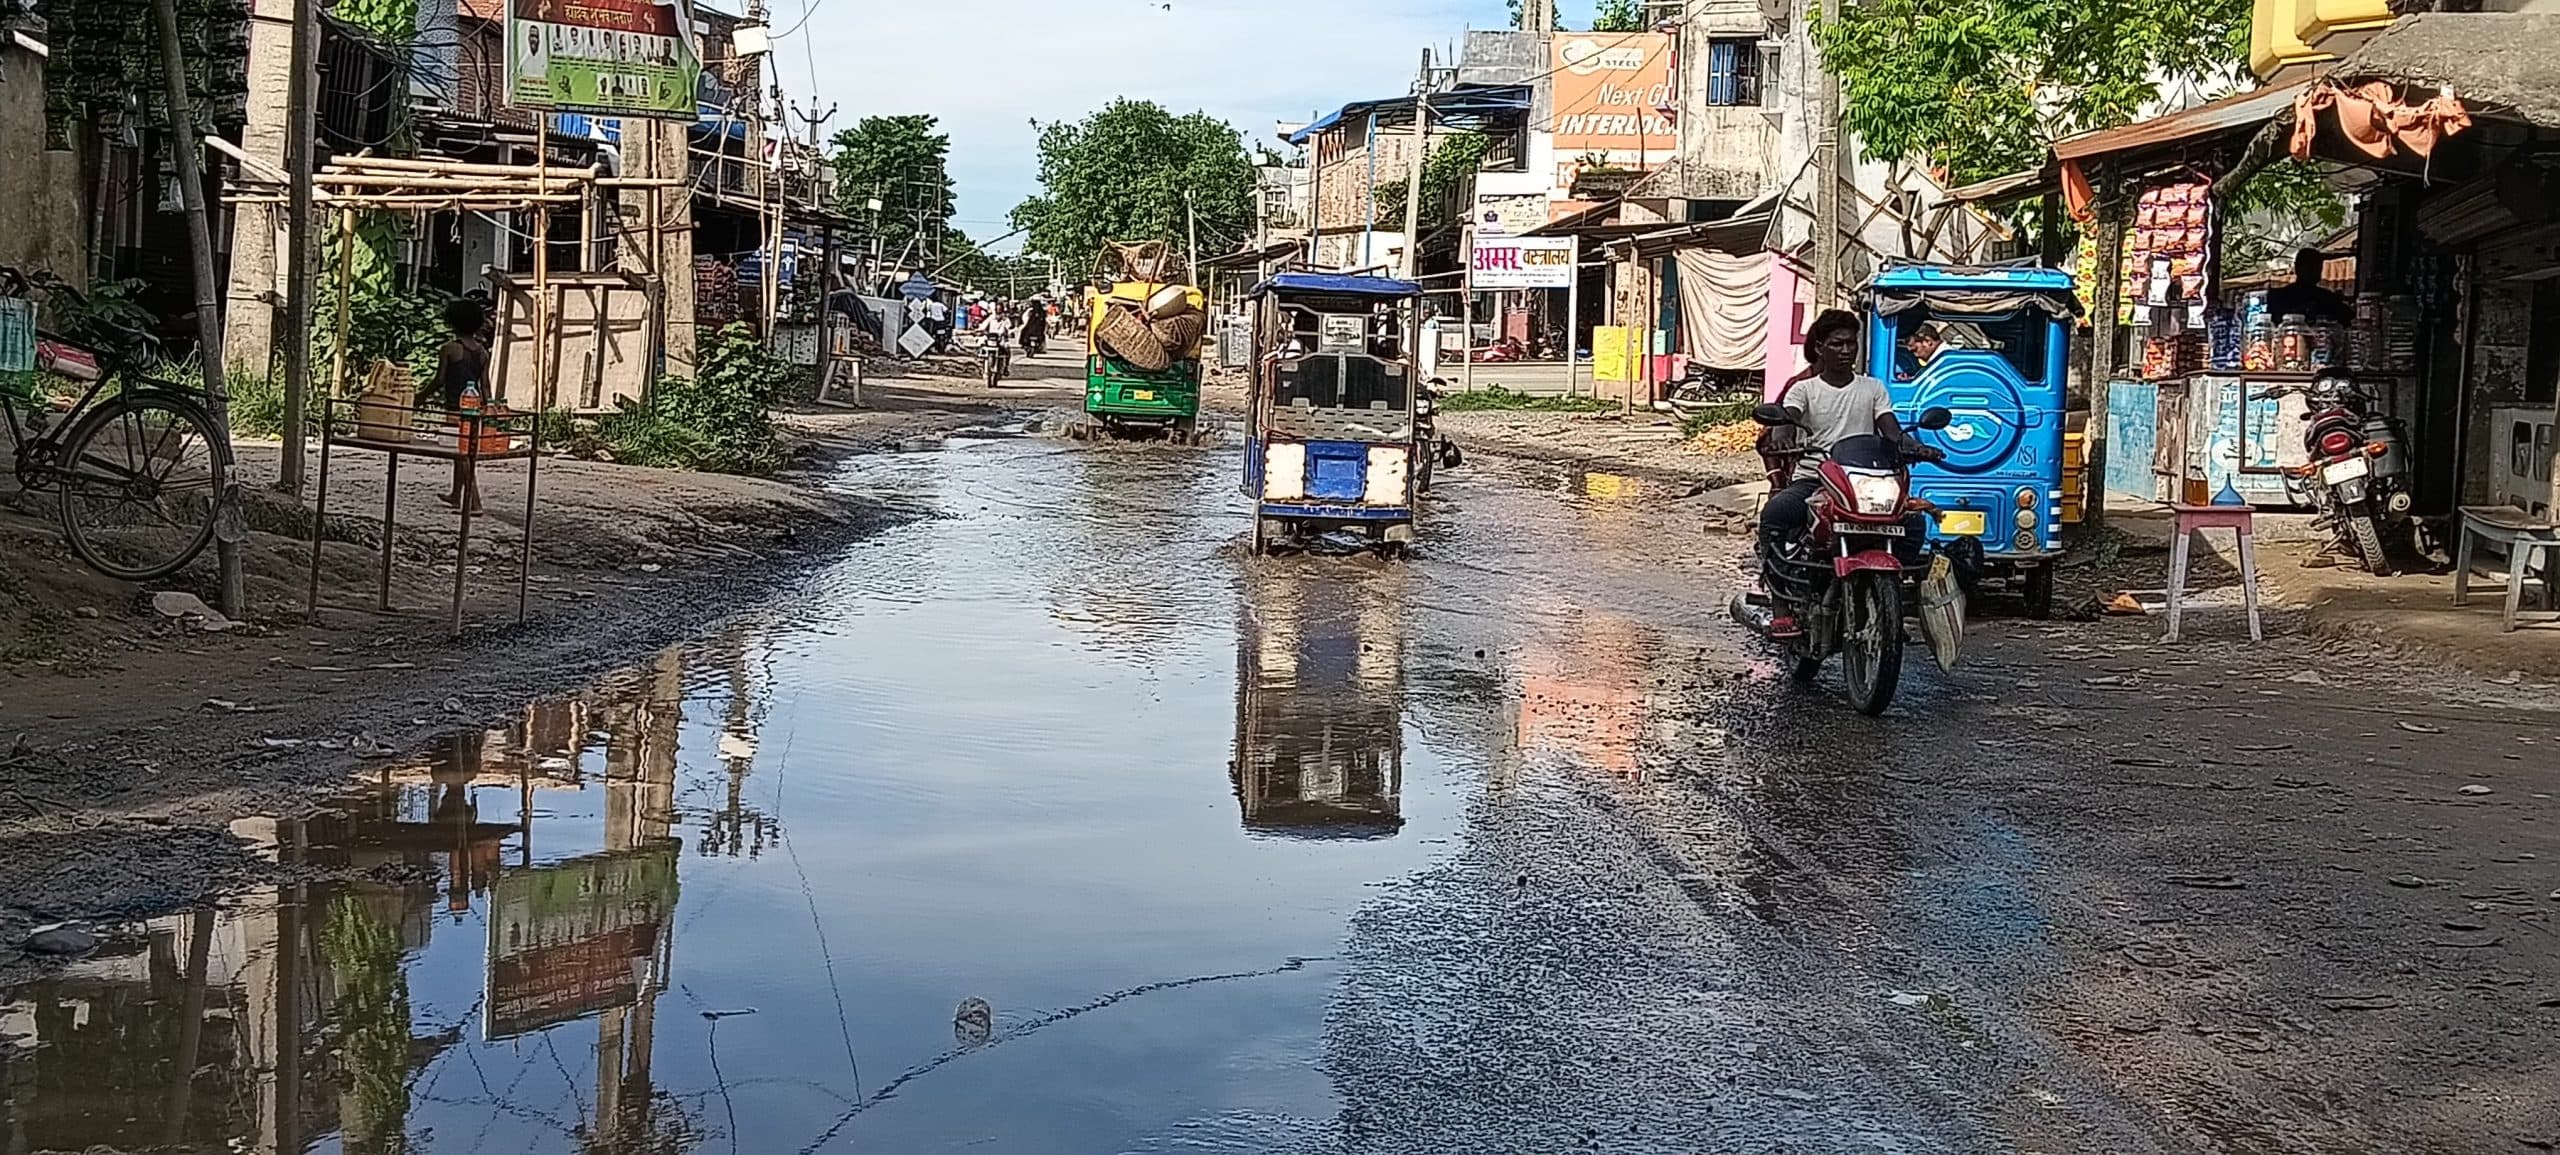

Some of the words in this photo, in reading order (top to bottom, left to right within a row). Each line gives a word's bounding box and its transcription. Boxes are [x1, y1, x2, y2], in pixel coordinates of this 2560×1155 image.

[1596, 83, 1644, 107] Next
[1473, 246, 1523, 271] अमर
[1523, 248, 1571, 266] वस्त्रालय
